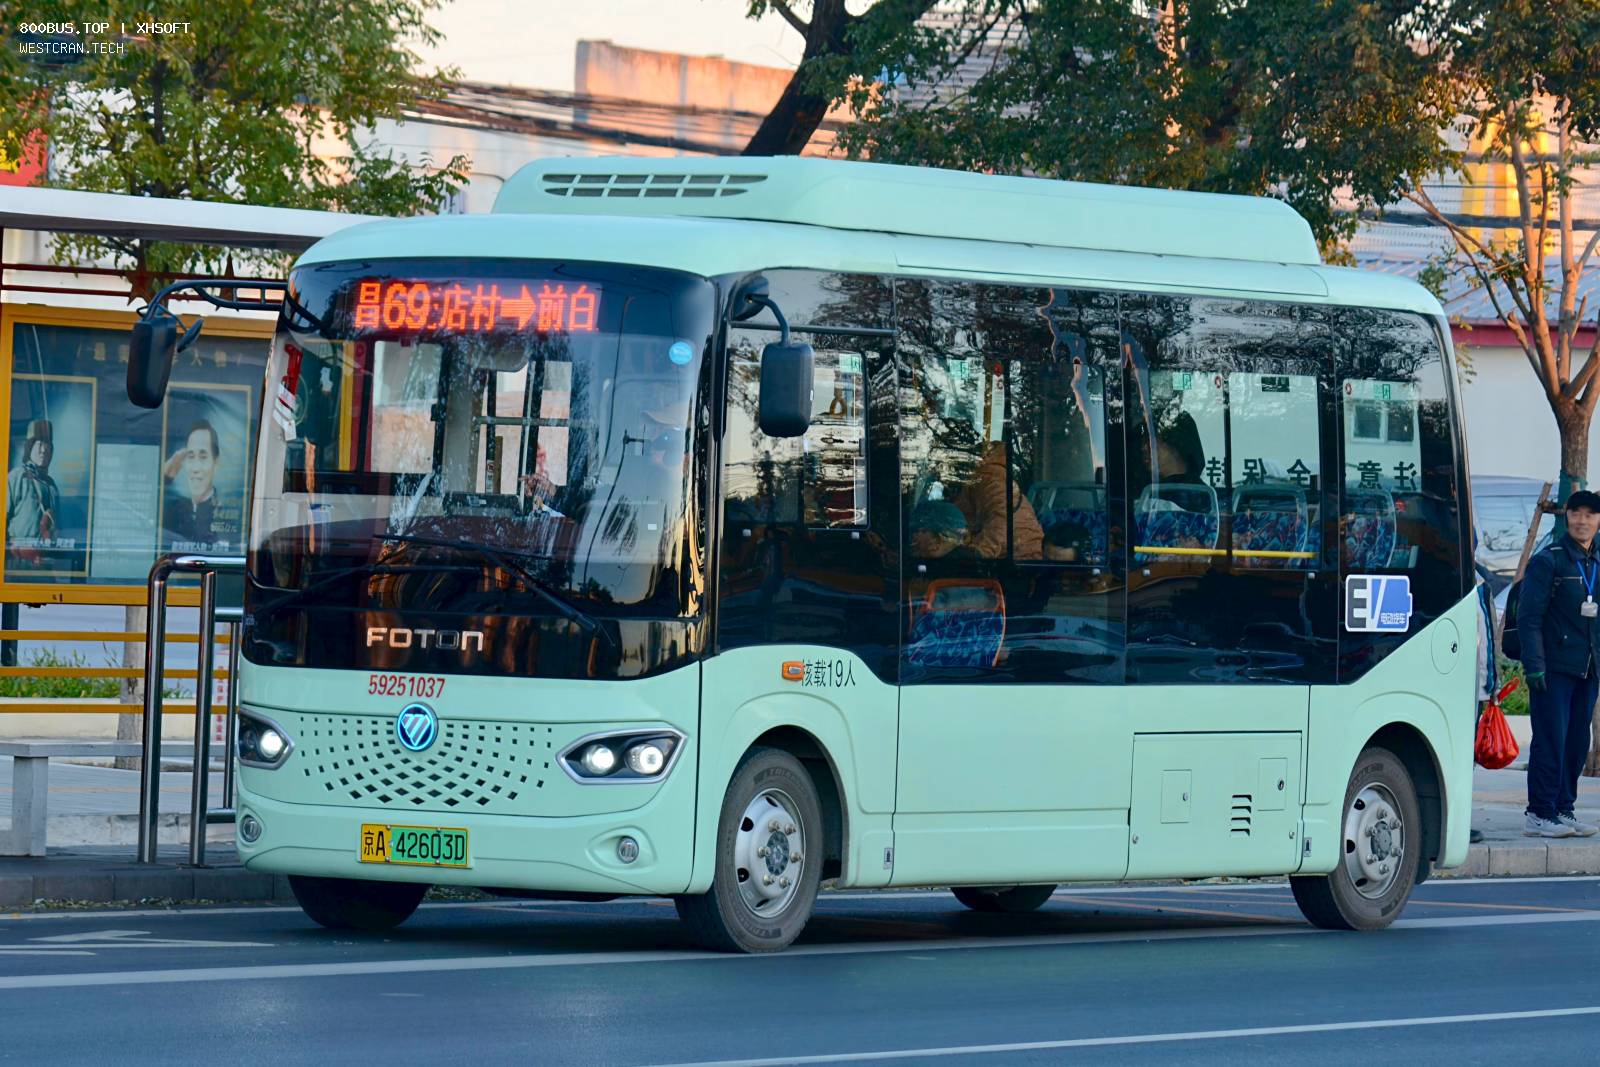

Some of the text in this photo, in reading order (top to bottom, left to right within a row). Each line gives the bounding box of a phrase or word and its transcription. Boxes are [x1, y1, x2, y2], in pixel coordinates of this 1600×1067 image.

[354, 282, 597, 331] 昌69 店村 前白
[366, 627, 484, 651] FOTON
[368, 674, 446, 698] 59251037
[801, 659, 856, 687] 核载19人
